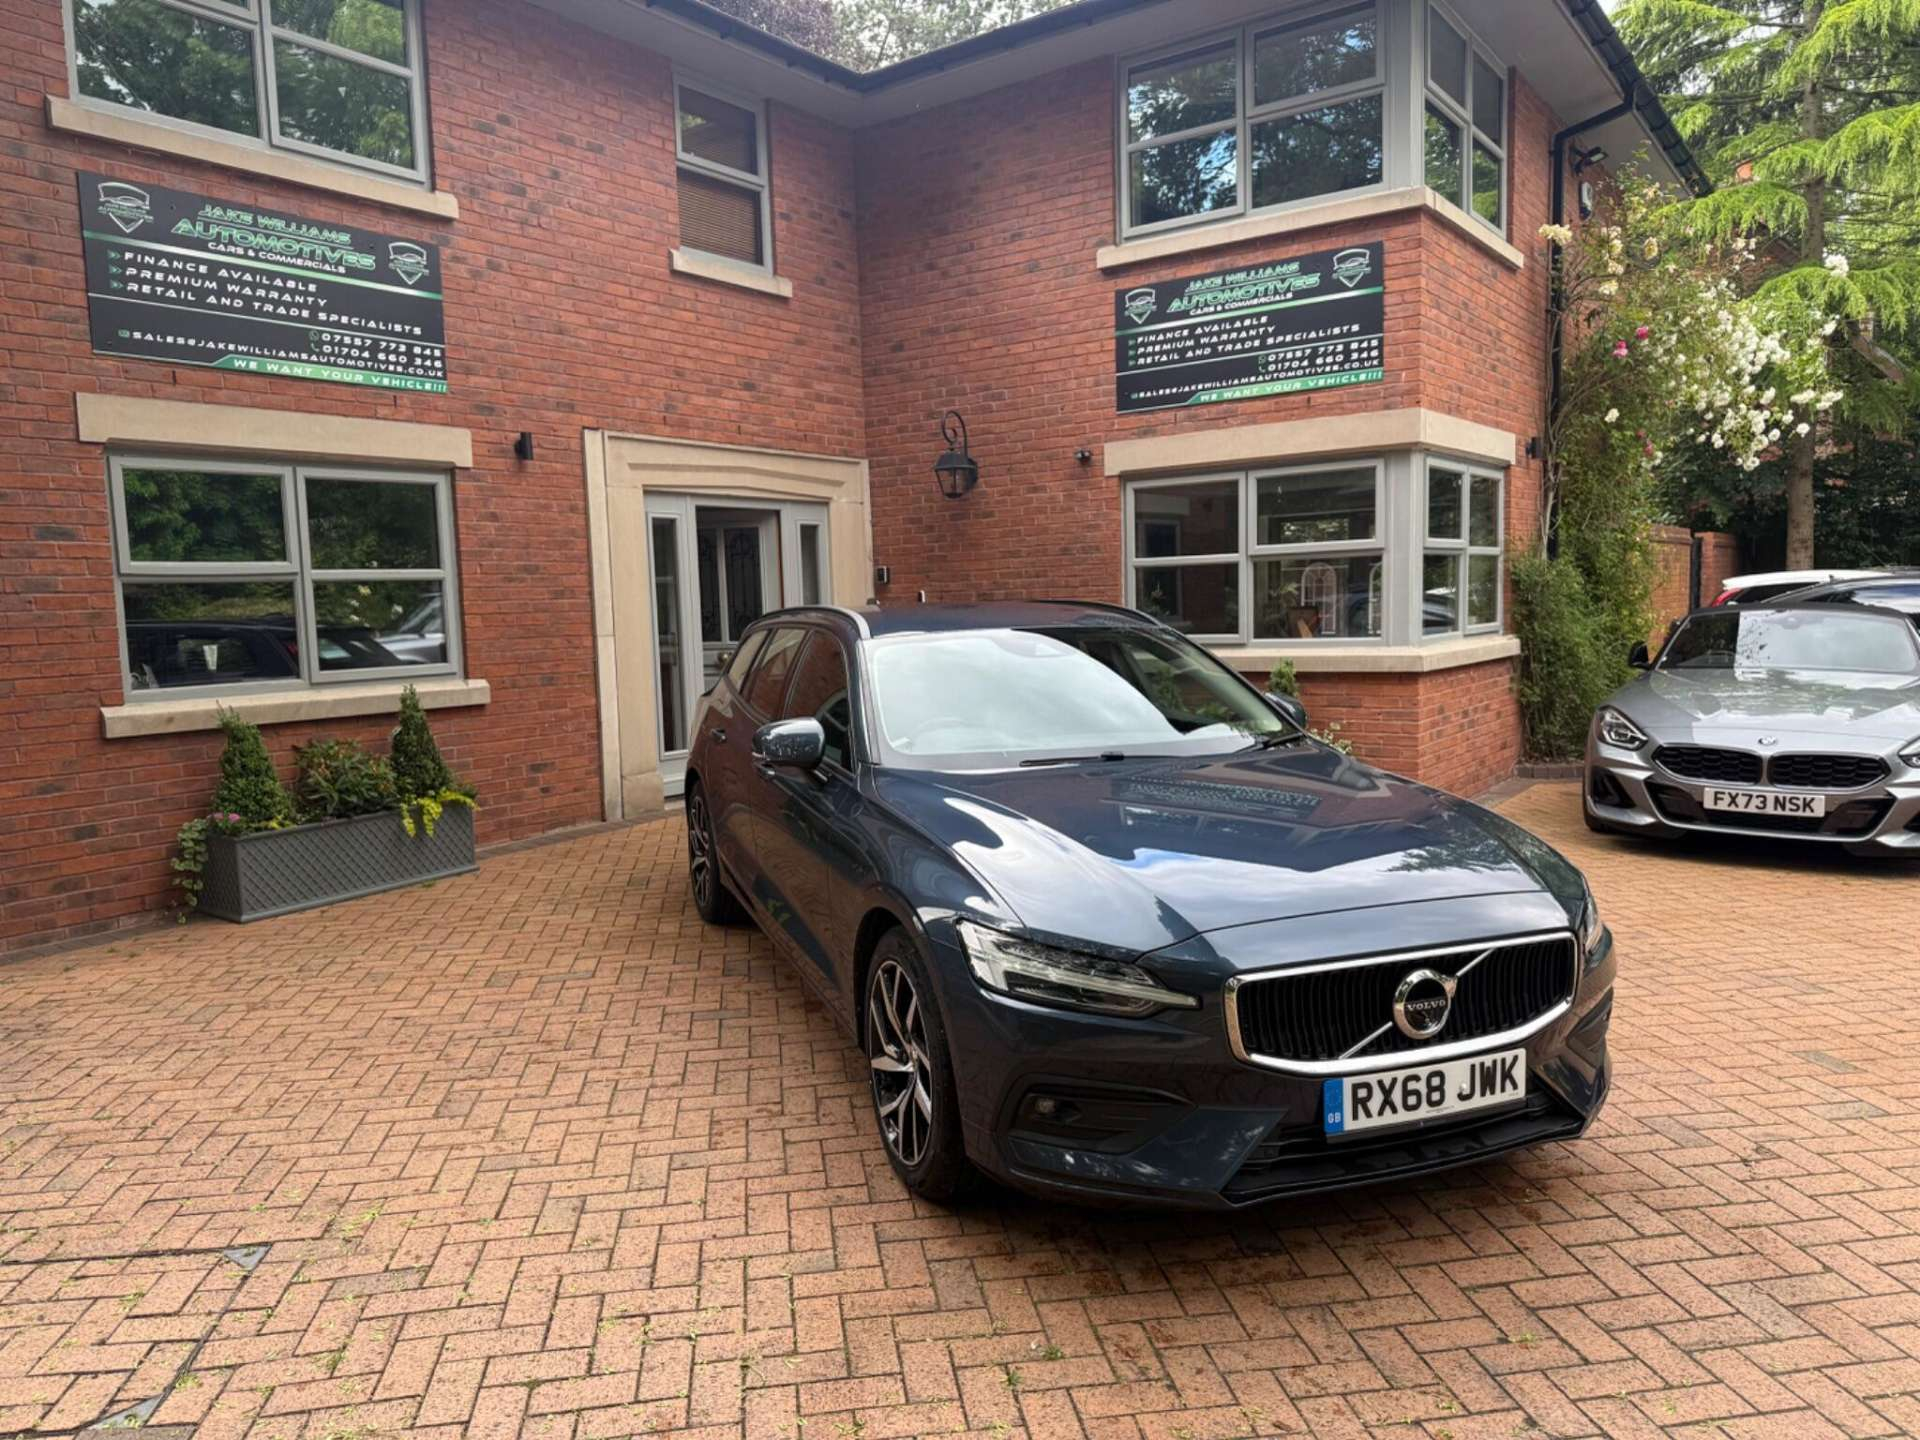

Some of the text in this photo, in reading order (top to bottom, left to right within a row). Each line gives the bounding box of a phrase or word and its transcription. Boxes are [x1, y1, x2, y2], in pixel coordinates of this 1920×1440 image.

[198, 204, 351, 245] JAKE WILLIAMS
[171, 218, 376, 271] AUTOMOTIVES
[208, 242, 346, 274] CARS & COMMERCIALS
[124, 251, 318, 292] FINANCE AVAILABLE
[126, 267, 328, 307] PREMIUM WARRANTY
[127, 282, 422, 335] RETAIL AND TRADE SPECIALISTS
[1166, 273, 1320, 313] AUTOMOTIVES
[321, 333, 373, 347] 07557
[1137, 316, 1268, 344] FINANCE AVAILABLE
[1137, 325, 1276, 355] PREMIUM WARRANTY
[1137, 324, 1360, 365] RETAIL AND TRADE SPECIALISTS
[322, 344, 371, 359] 01704
[378, 352, 407, 363] 660
[1268, 360, 1309, 372] 01704
[233, 359, 447, 393] WE WANT YOUR VEHICLE!!!
[1200, 393, 1218, 402] WE
[1223, 387, 1261, 398] WANT
[1265, 382, 1301, 393] YOUR
[1713, 791, 1815, 813] FX73 NSK
[1406, 999, 1446, 1011] VOLVO
[1351, 1055, 1519, 1121] RX68 JWK
[1327, 1112, 1341, 1124] GB
